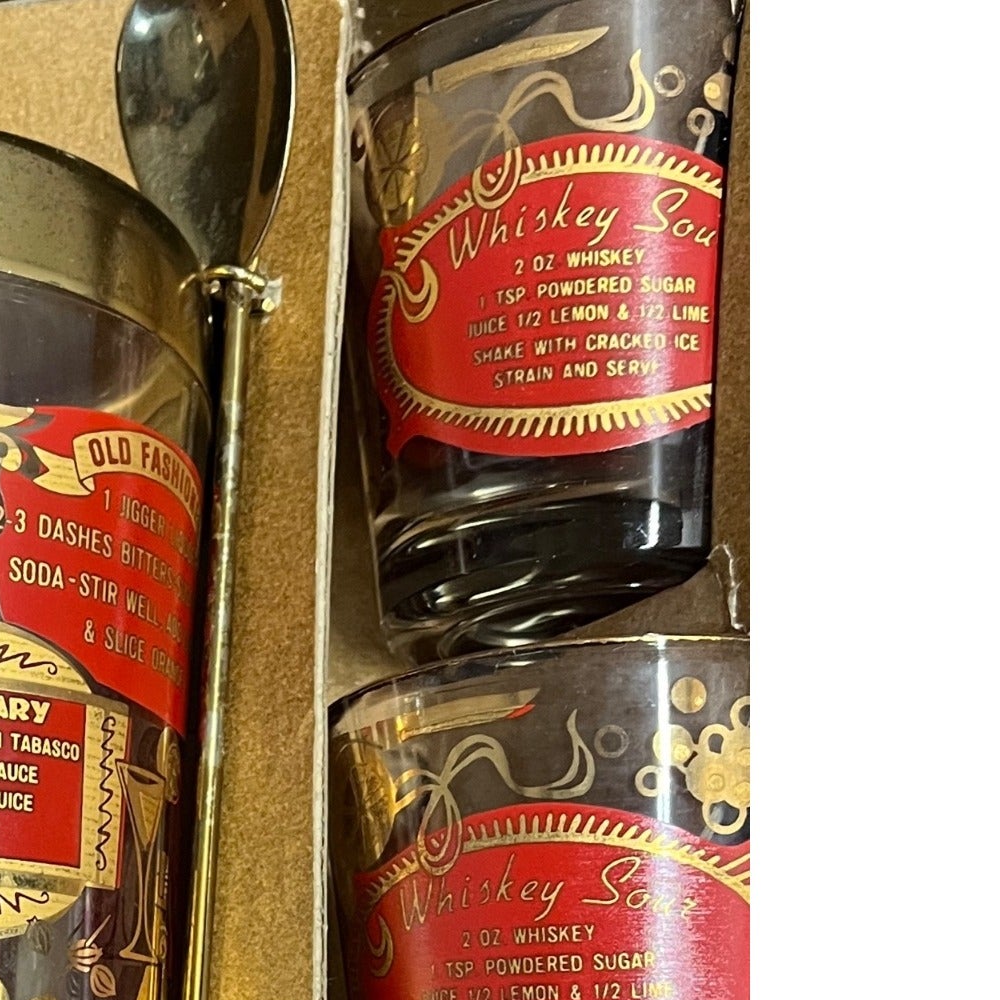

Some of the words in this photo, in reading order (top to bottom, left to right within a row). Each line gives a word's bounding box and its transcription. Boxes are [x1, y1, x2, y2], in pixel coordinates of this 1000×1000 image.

[448, 180, 619, 271] Whiskey
[514, 258, 524, 274] 2
[533, 255, 554, 273] OZ
[566, 248, 647, 268] WHISKEY
[496, 288, 526, 307] TSP
[537, 277, 632, 299] POWDERED
[639, 276, 696, 295] SUGAR
[467, 317, 508, 339] JUICE
[517, 311, 542, 329] 1/2
[551, 304, 609, 325] LEMON
[617, 304, 629, 321] &
[672, 305, 710, 323] LIME
[472, 343, 525, 366] SHAKE
[534, 337, 576, 357] WITH
[585, 333, 667, 353] CRACKED
[675, 333, 700, 352] ICE
[493, 367, 553, 389] STRAIN
[563, 360, 599, 379] AND
[88, 436, 132, 467] OLD
[104, 489, 111, 511] 1
[120, 495, 166, 536] JIGGER
[38, 513, 113, 559] DASHES
[84, 620, 95, 644] &
[105, 626, 146, 664] SLICE
[11, 733, 80, 761] TABASCO
[400, 853, 565, 931] Whiskey
[581, 856, 699, 922] Sour
[462, 931, 471, 947] 2
[480, 928, 500, 947] OZ
[513, 925, 596, 945] WHISKEY
[446, 960, 474, 979] TSP
[486, 955, 583, 976] POWDERED
[593, 951, 655, 971] SUGAR
[570, 984, 581, 1000] &
[594, 983, 620, 1000] 1/2
